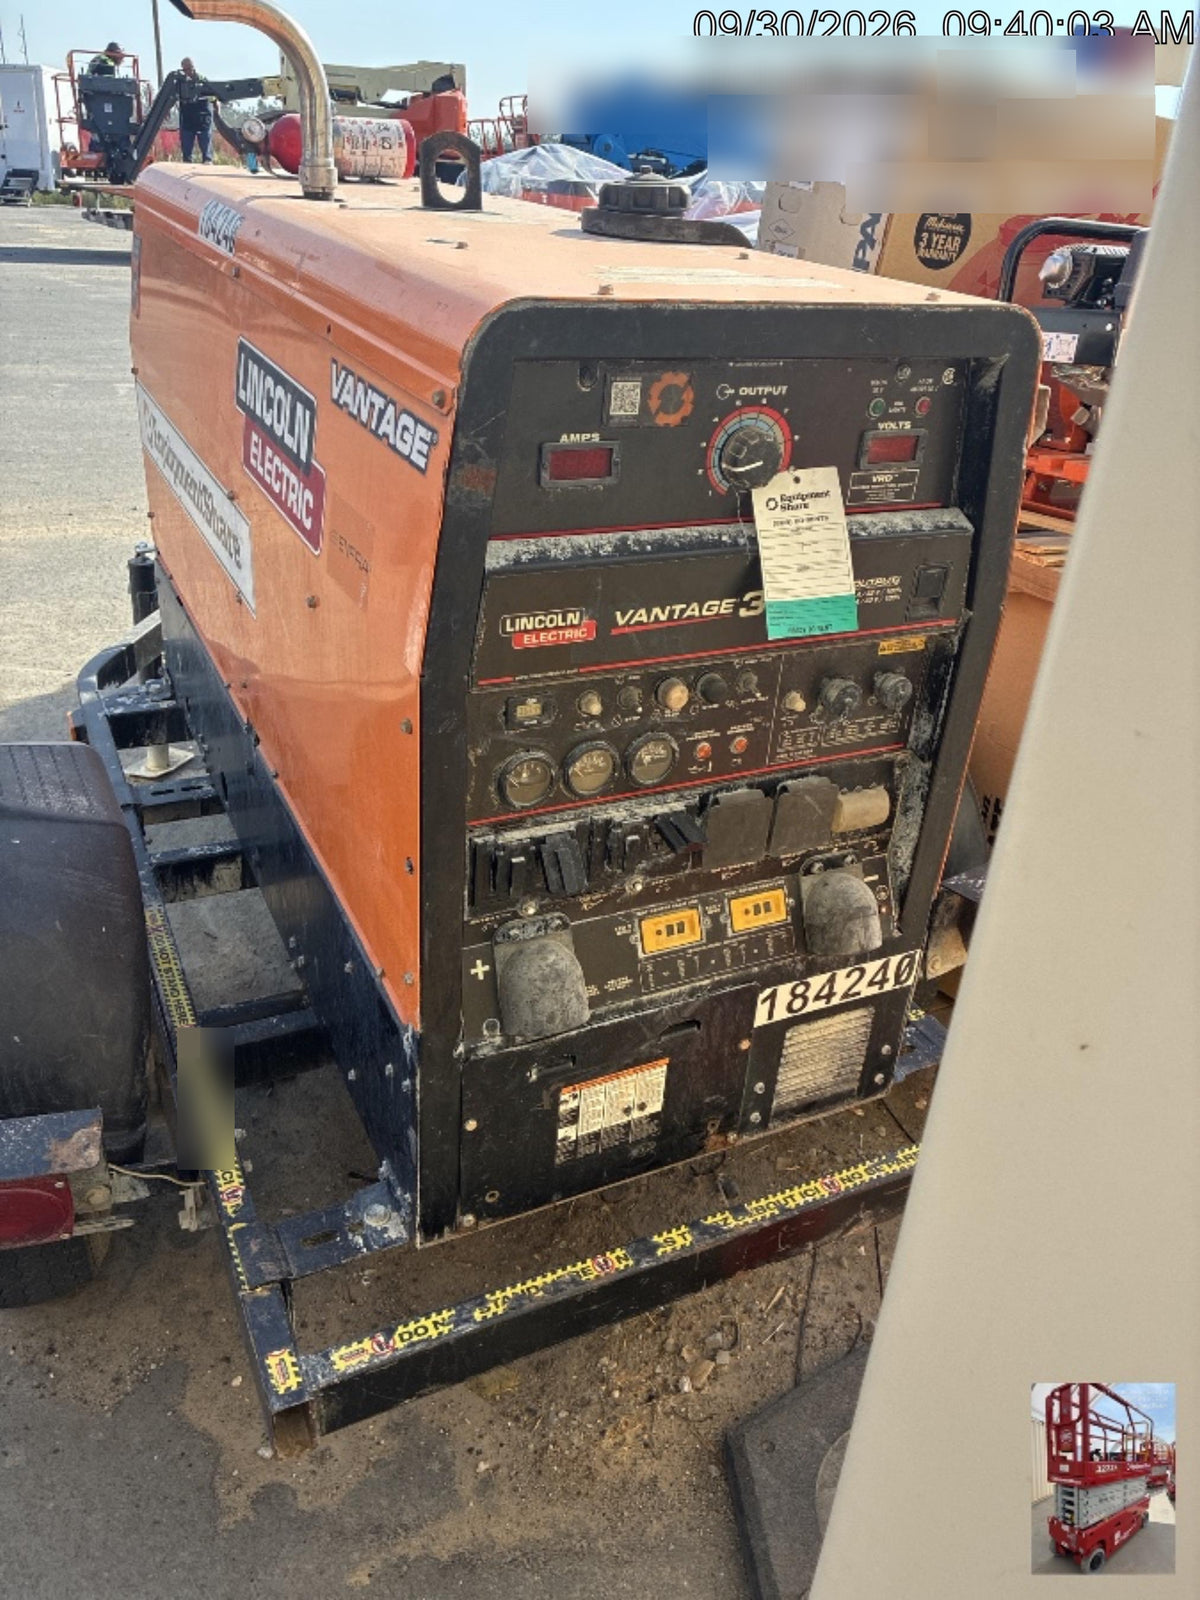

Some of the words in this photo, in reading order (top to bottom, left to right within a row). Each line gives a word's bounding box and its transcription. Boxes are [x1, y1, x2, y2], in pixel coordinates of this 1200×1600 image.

[852, 213, 882, 270] PA
[919, 232, 929, 248] 3
[931, 232, 961, 251] YEAR
[739, 385, 789, 397] OUTPUT
[238, 351, 311, 464] LINCOLN
[330, 361, 433, 468] VANTAGE
[877, 420, 912, 430] VOLTS
[559, 432, 601, 444] AMPS
[249, 431, 314, 532] ELECTRIC
[872, 474, 894, 483] VRD
[780, 490, 831, 504] Equipment
[780, 502, 809, 512] Share
[615, 598, 736, 627] VANTAGE
[738, 590, 765, 618] 3
[505, 610, 581, 633] LINCOLN
[523, 627, 588, 646] ELECTRIC
[163, 966, 181, 998] STAND
[759, 951, 917, 1022] 184240
[799, 1186, 821, 1199] ICI
[398, 1325, 430, 1344] DO
